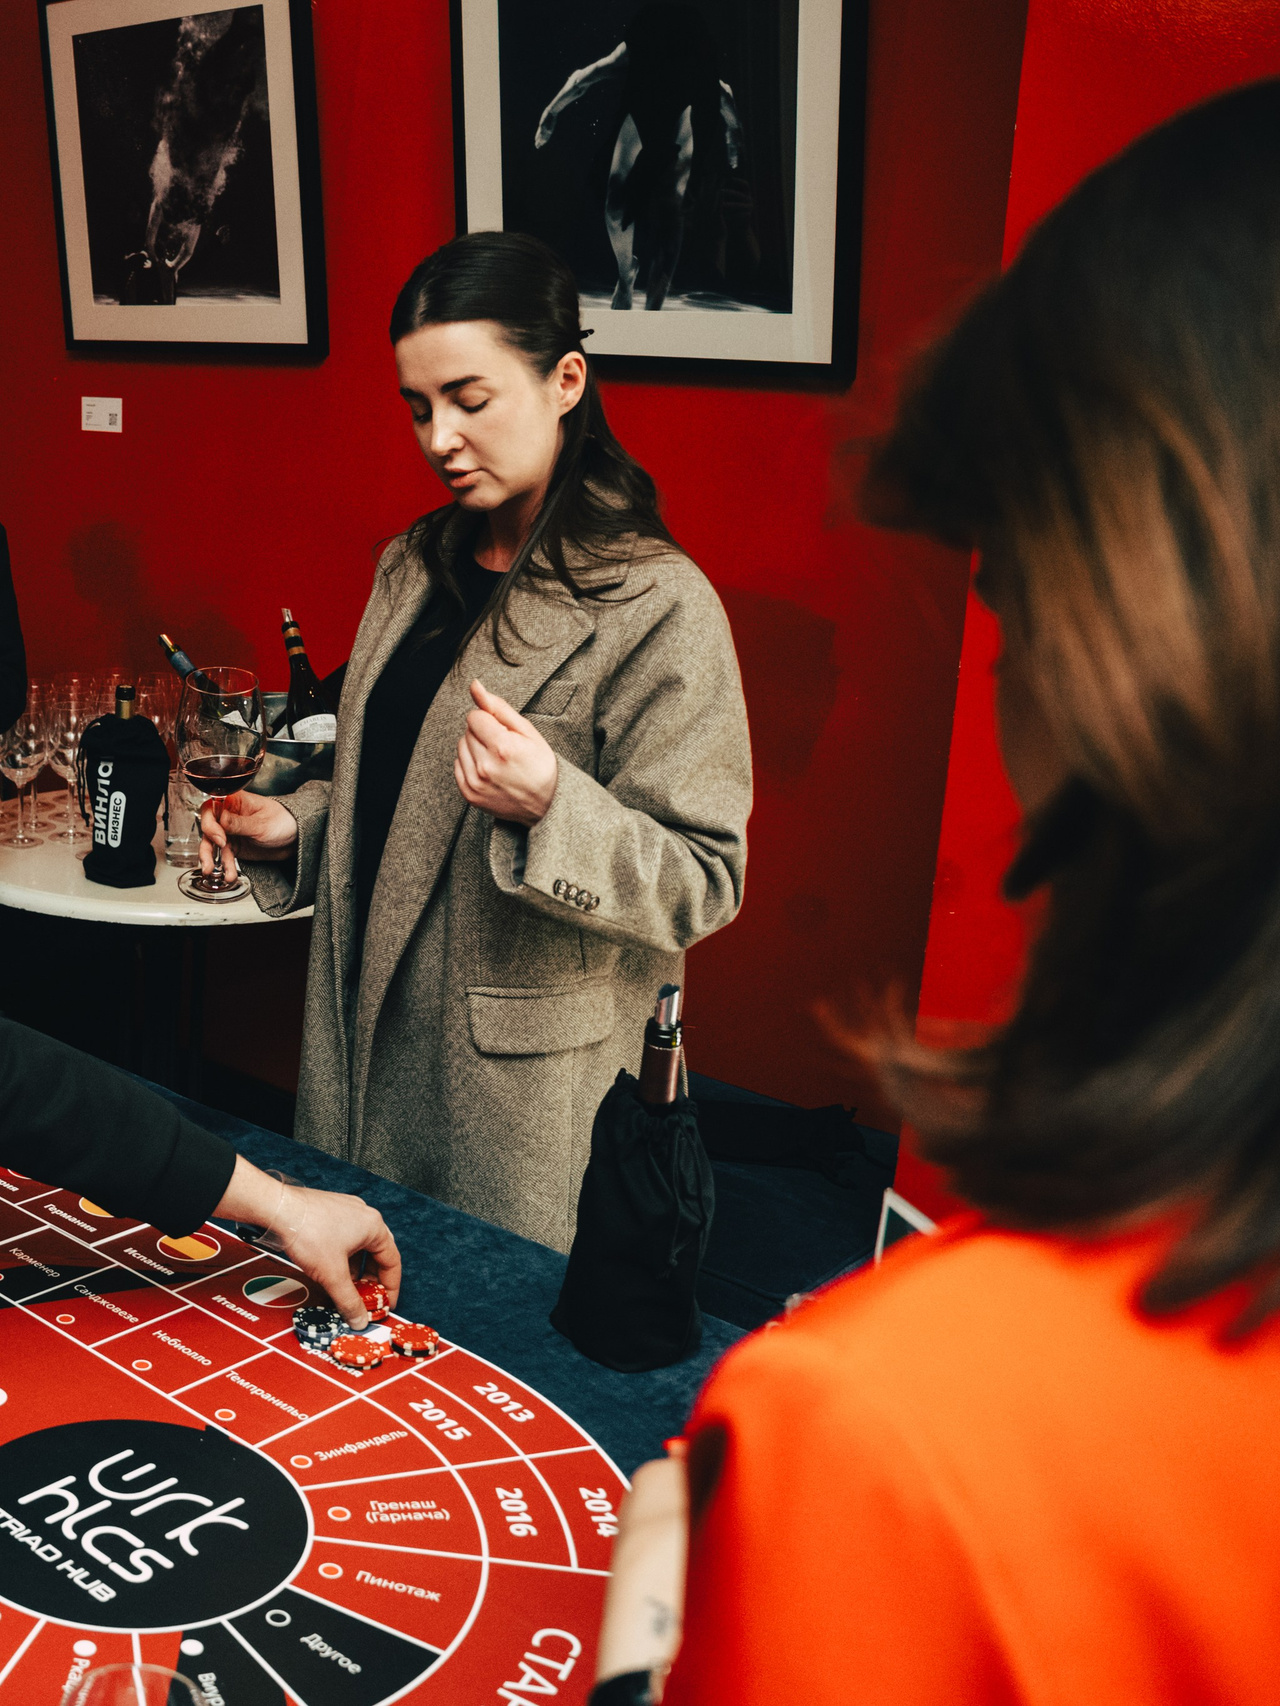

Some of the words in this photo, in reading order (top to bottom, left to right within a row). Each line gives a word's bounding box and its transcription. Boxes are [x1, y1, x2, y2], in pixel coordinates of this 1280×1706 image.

[110, 797, 123, 842] БИЗНЕС
[43, 1203, 97, 1233] Германия
[9, 1247, 61, 1278] Карменер
[123, 1247, 175, 1276] Испания
[74, 1284, 139, 1323] Санджовезе
[211, 1294, 260, 1322] Италия
[152, 1329, 212, 1366] Небиолло
[225, 1370, 309, 1422] Темпранильо
[472, 1382, 535, 1423] 2013
[409, 1398, 471, 1441] 2015
[314, 1427, 409, 1463] Зинфандель
[365, 1508, 451, 1524] (Гарнача)
[369, 1499, 437, 1512] Гренаш
[495, 1487, 538, 1537] 2016
[578, 1486, 619, 1537] 2014
[56, 1559, 117, 1603] HUB
[355, 1570, 442, 1602] Пинотаж
[300, 1632, 362, 1674] Другое
